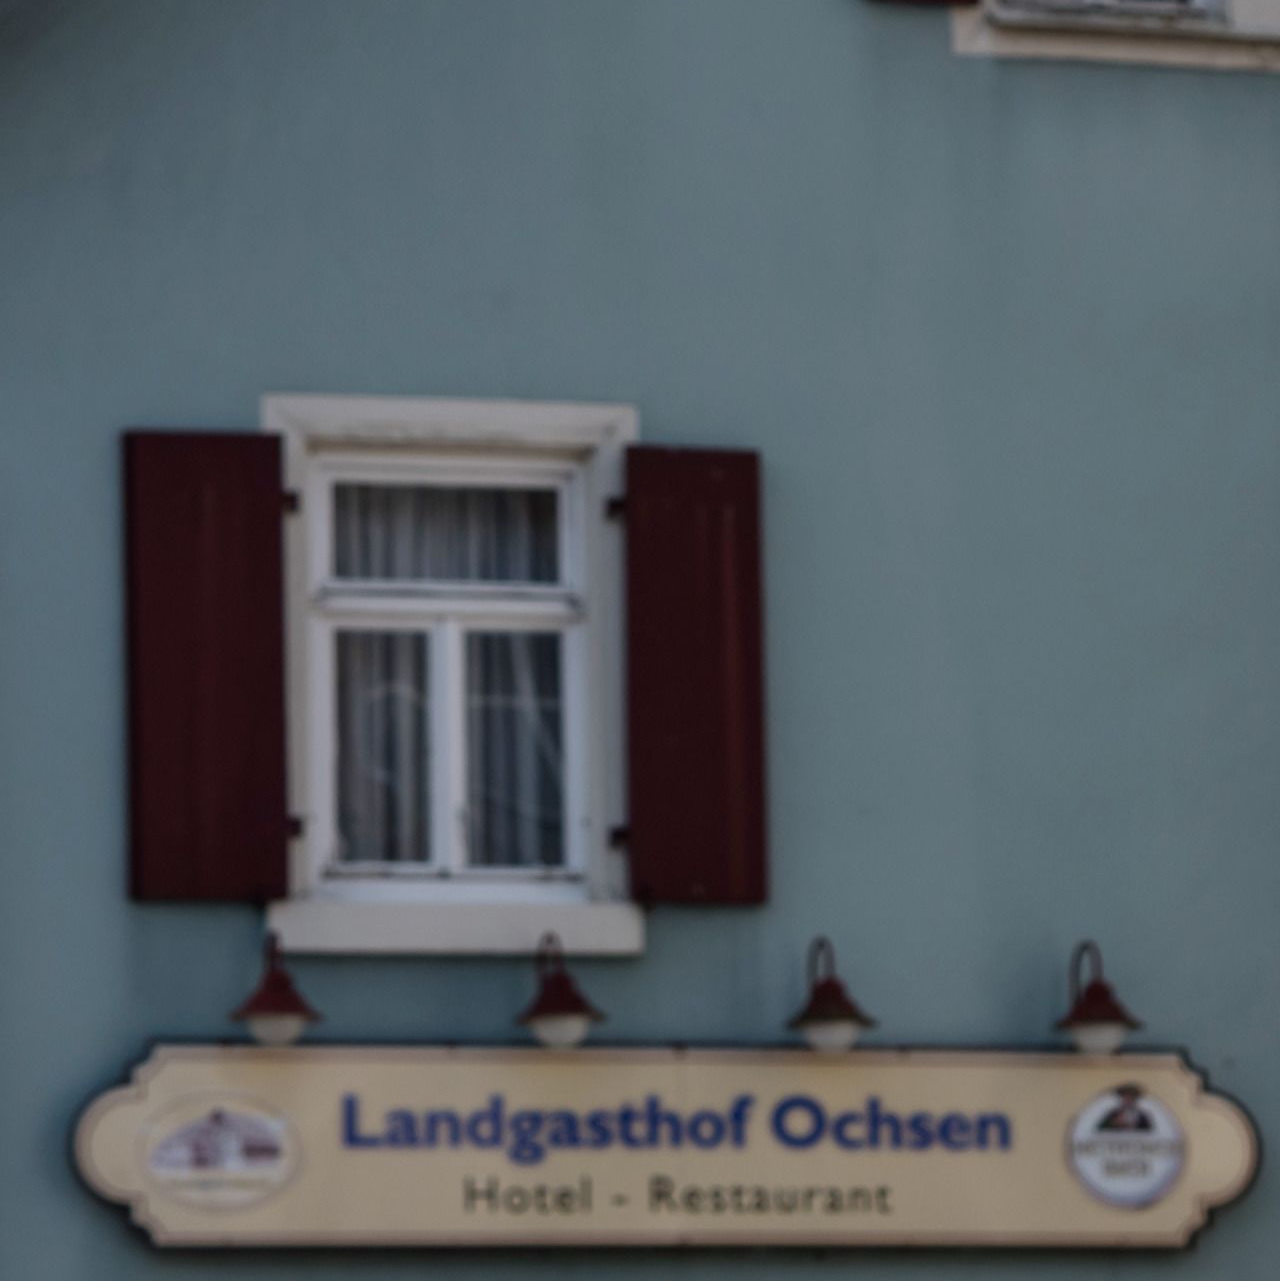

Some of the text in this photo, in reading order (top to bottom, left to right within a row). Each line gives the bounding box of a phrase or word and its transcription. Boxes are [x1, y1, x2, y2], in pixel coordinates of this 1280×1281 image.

[343, 1095, 1010, 1165] Landgasthof Ochsen
[466, 1182, 591, 1213] Hotel
[650, 1176, 889, 1213] Restaurant
